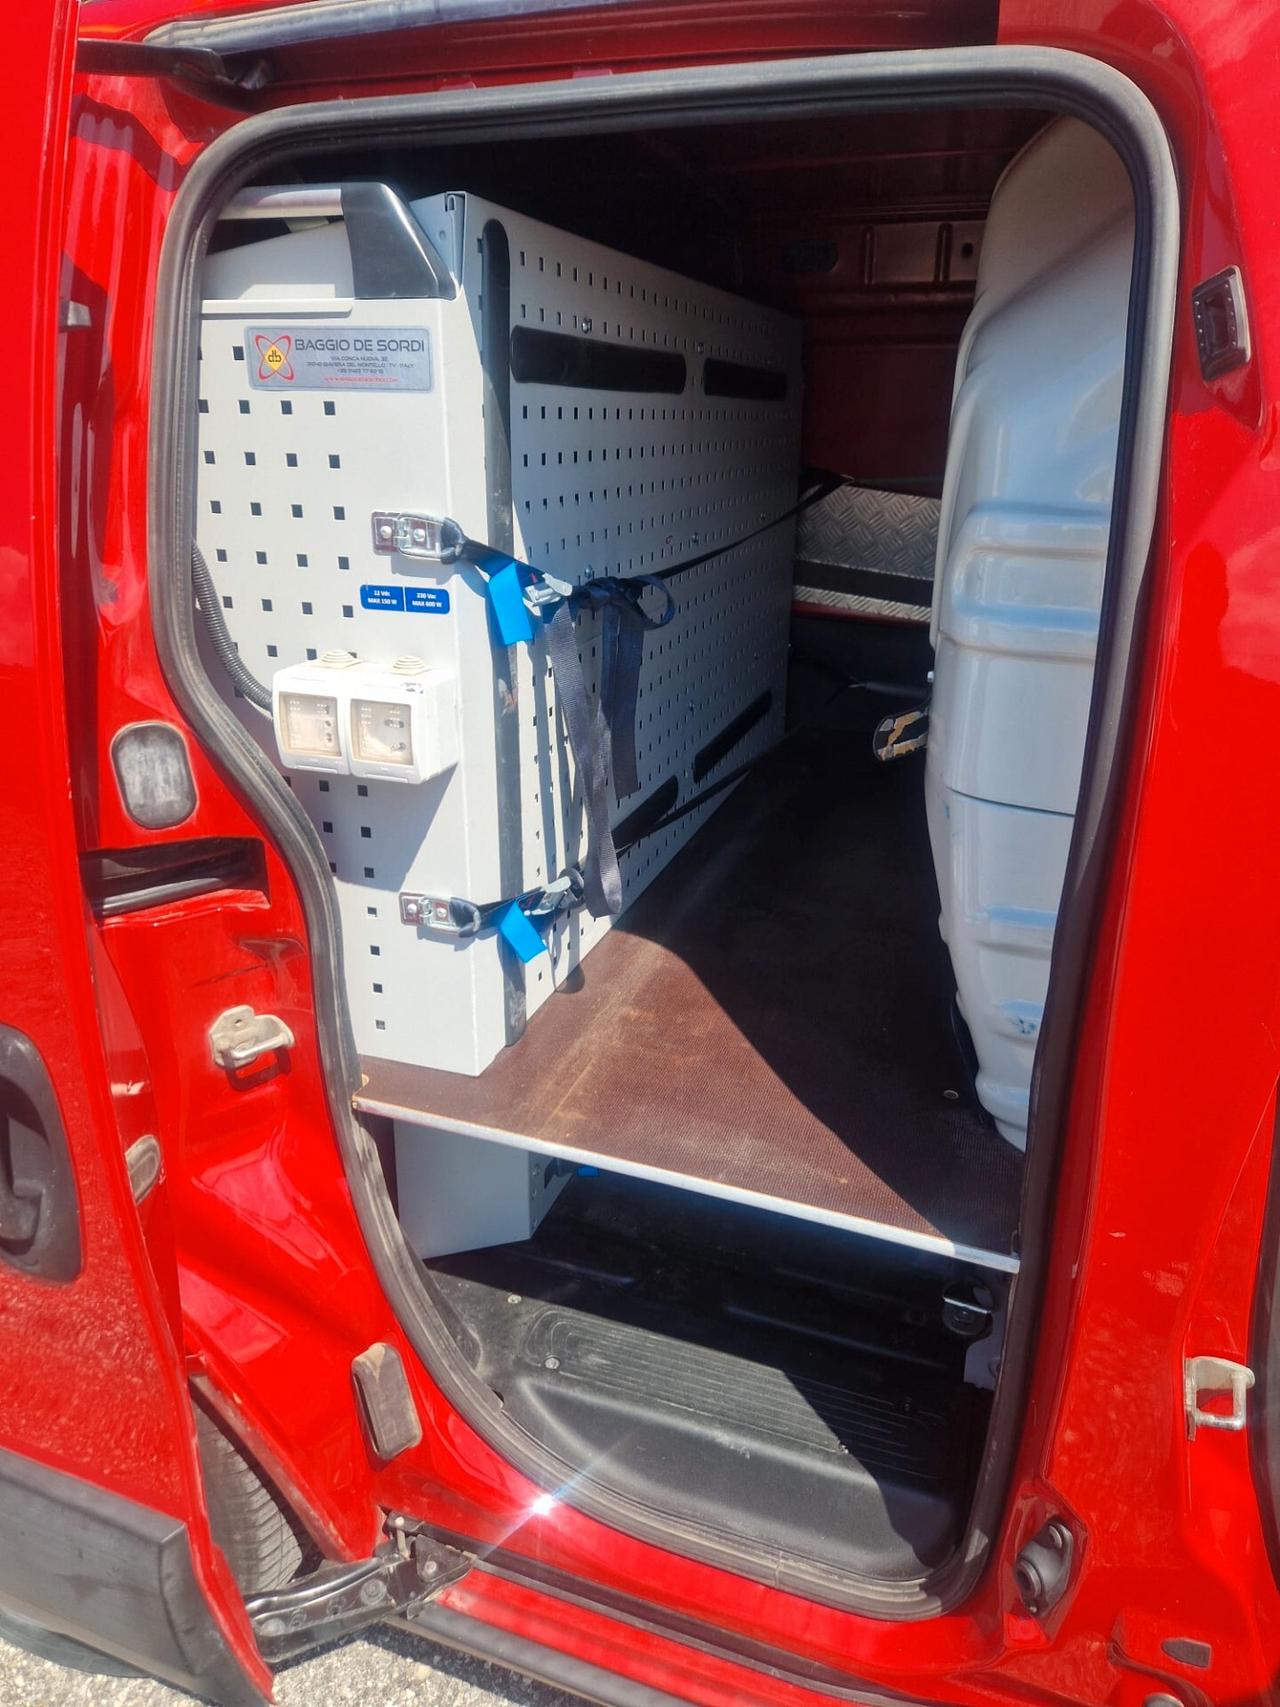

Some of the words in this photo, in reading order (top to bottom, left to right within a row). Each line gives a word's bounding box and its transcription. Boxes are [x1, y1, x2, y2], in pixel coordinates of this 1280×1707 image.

[294, 339, 350, 351] BAGGIO
[353, 339, 373, 351] DE
[376, 340, 425, 352] SORDI
